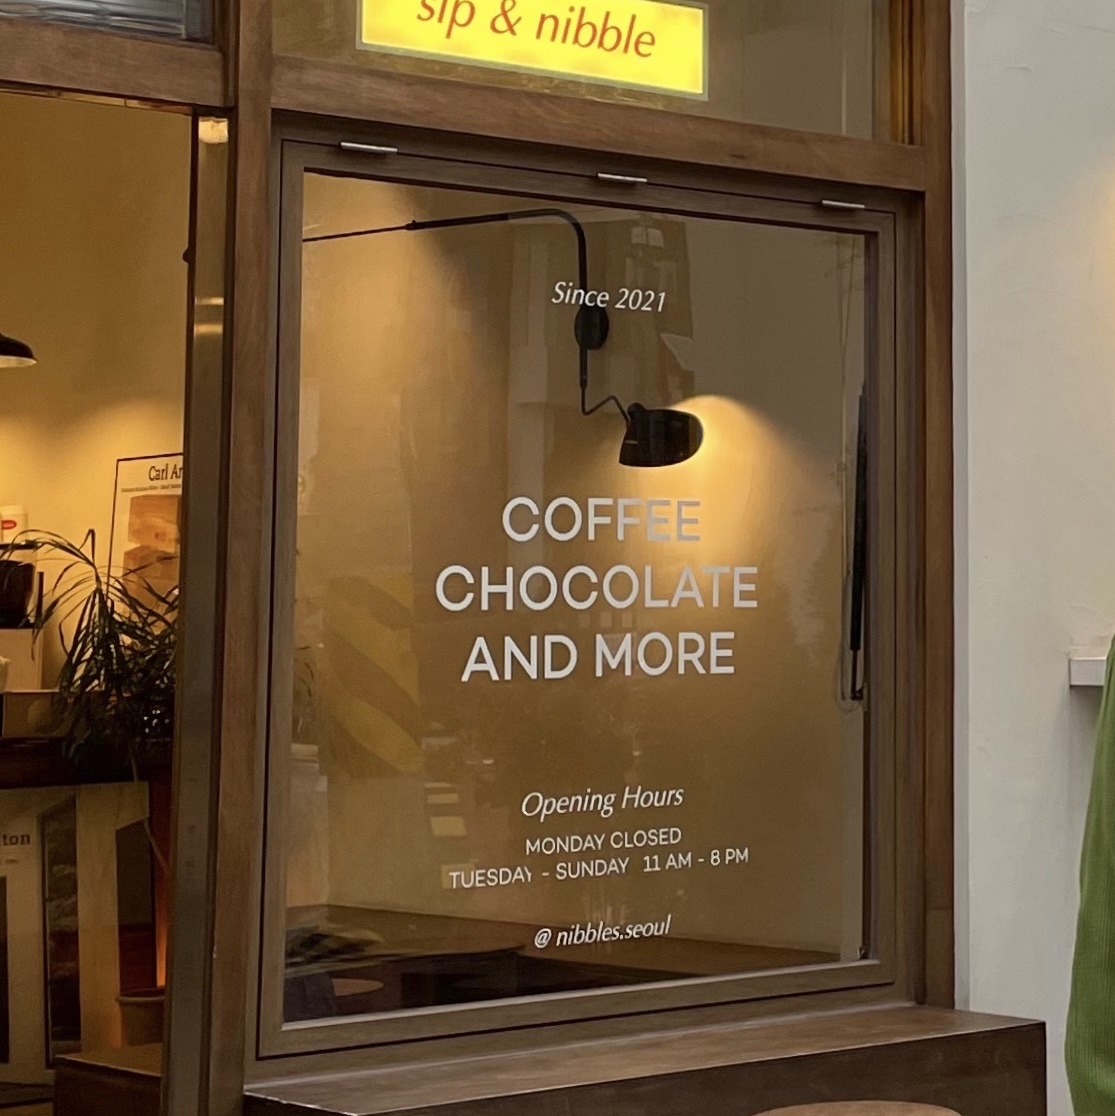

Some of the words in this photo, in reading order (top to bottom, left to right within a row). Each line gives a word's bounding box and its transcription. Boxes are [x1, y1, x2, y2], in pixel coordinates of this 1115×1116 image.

[489, 0, 522, 36] &
[535, 5, 656, 58] nibble
[551, 281, 610, 308] Since
[614, 287, 666, 313] 2021
[148, 462, 169, 482] Carl
[502, 496, 701, 542] COFFEE
[435, 564, 758, 611] CHOCOLATE
[461, 634, 578, 682] AND
[595, 631, 735, 677] MORE
[521, 788, 617, 822] Opening
[621, 785, 685, 809] Hours
[525, 834, 606, 856] MONDAY
[610, 827, 682, 849] CLOSED
[449, 865, 533, 890] TUESDAY
[555, 857, 630, 880] SUNDAY
[643, 855, 660, 873] 11
[665, 852, 693, 870] AM
[710, 849, 720, 866] 8
[725, 847, 749, 864] PM
[556, 914, 672, 947] nibbles.seoul
